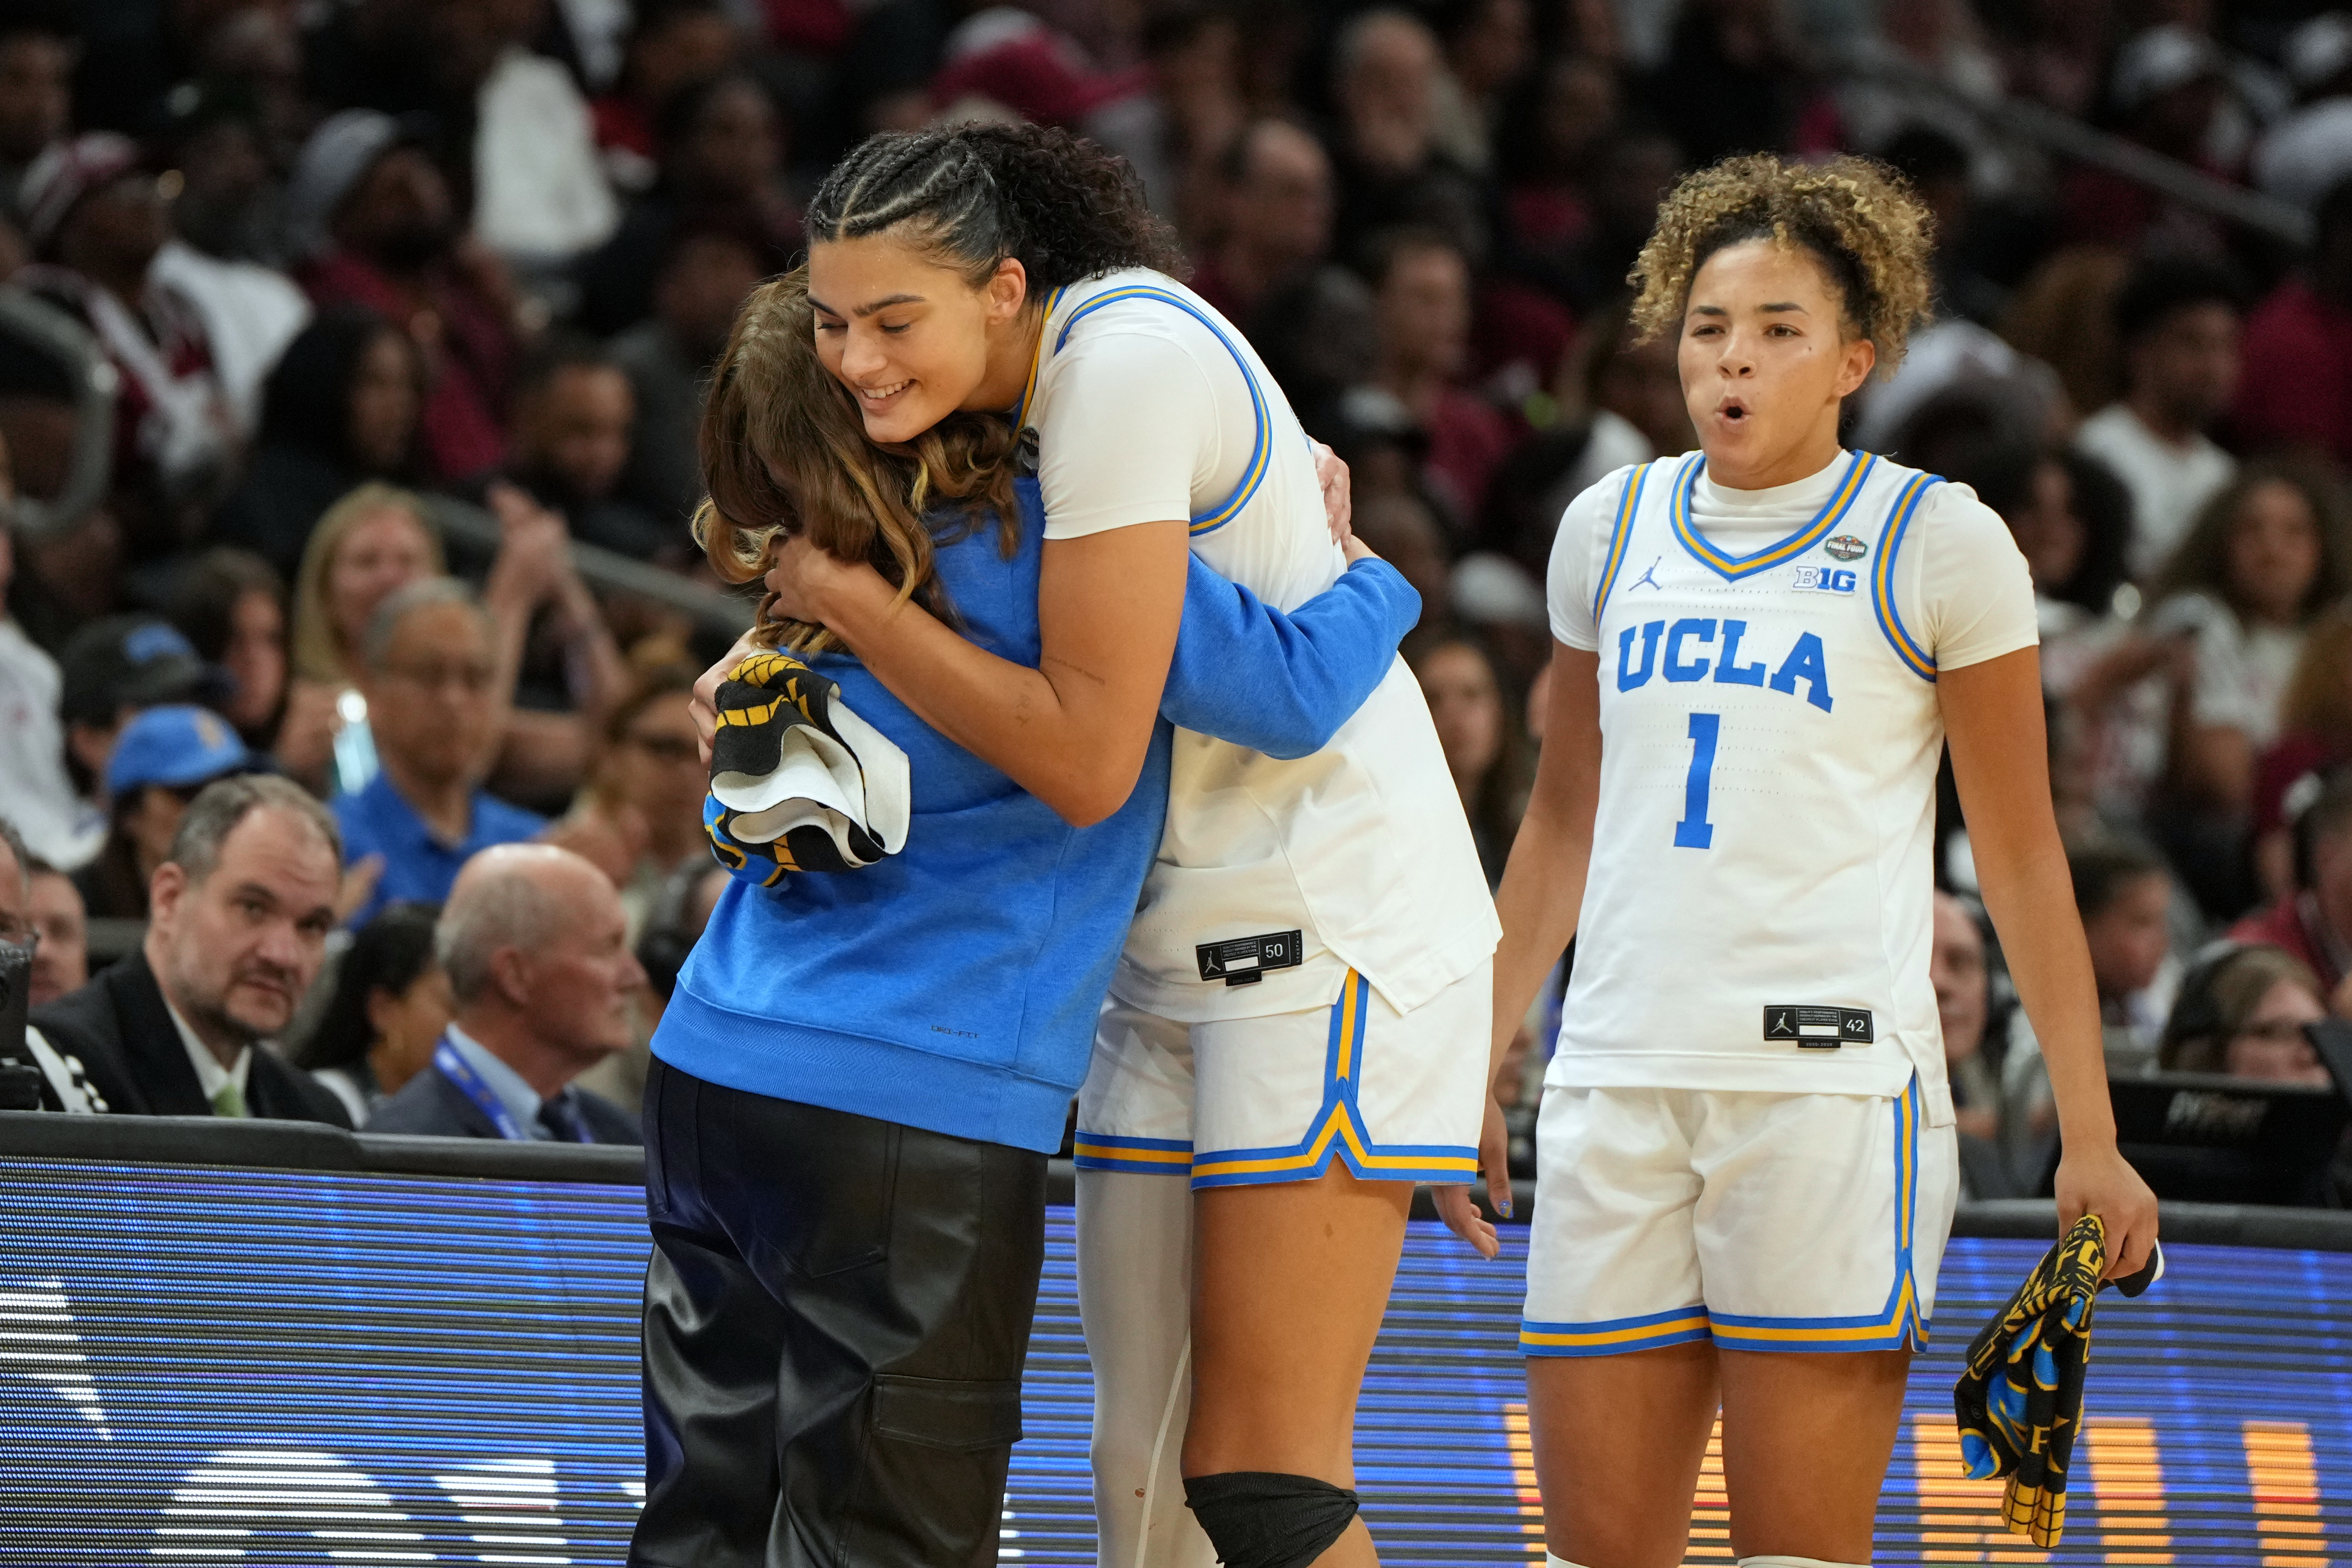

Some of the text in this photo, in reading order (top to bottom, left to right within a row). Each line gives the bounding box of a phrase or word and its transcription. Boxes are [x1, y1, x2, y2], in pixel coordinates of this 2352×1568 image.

[1827, 540, 1865, 553] FINAL FOUR
[1617, 618, 1833, 713] UCLA
[1674, 713, 1720, 849] 1
[1266, 943, 1283, 959] 50
[1846, 1019, 1865, 1032] 42
